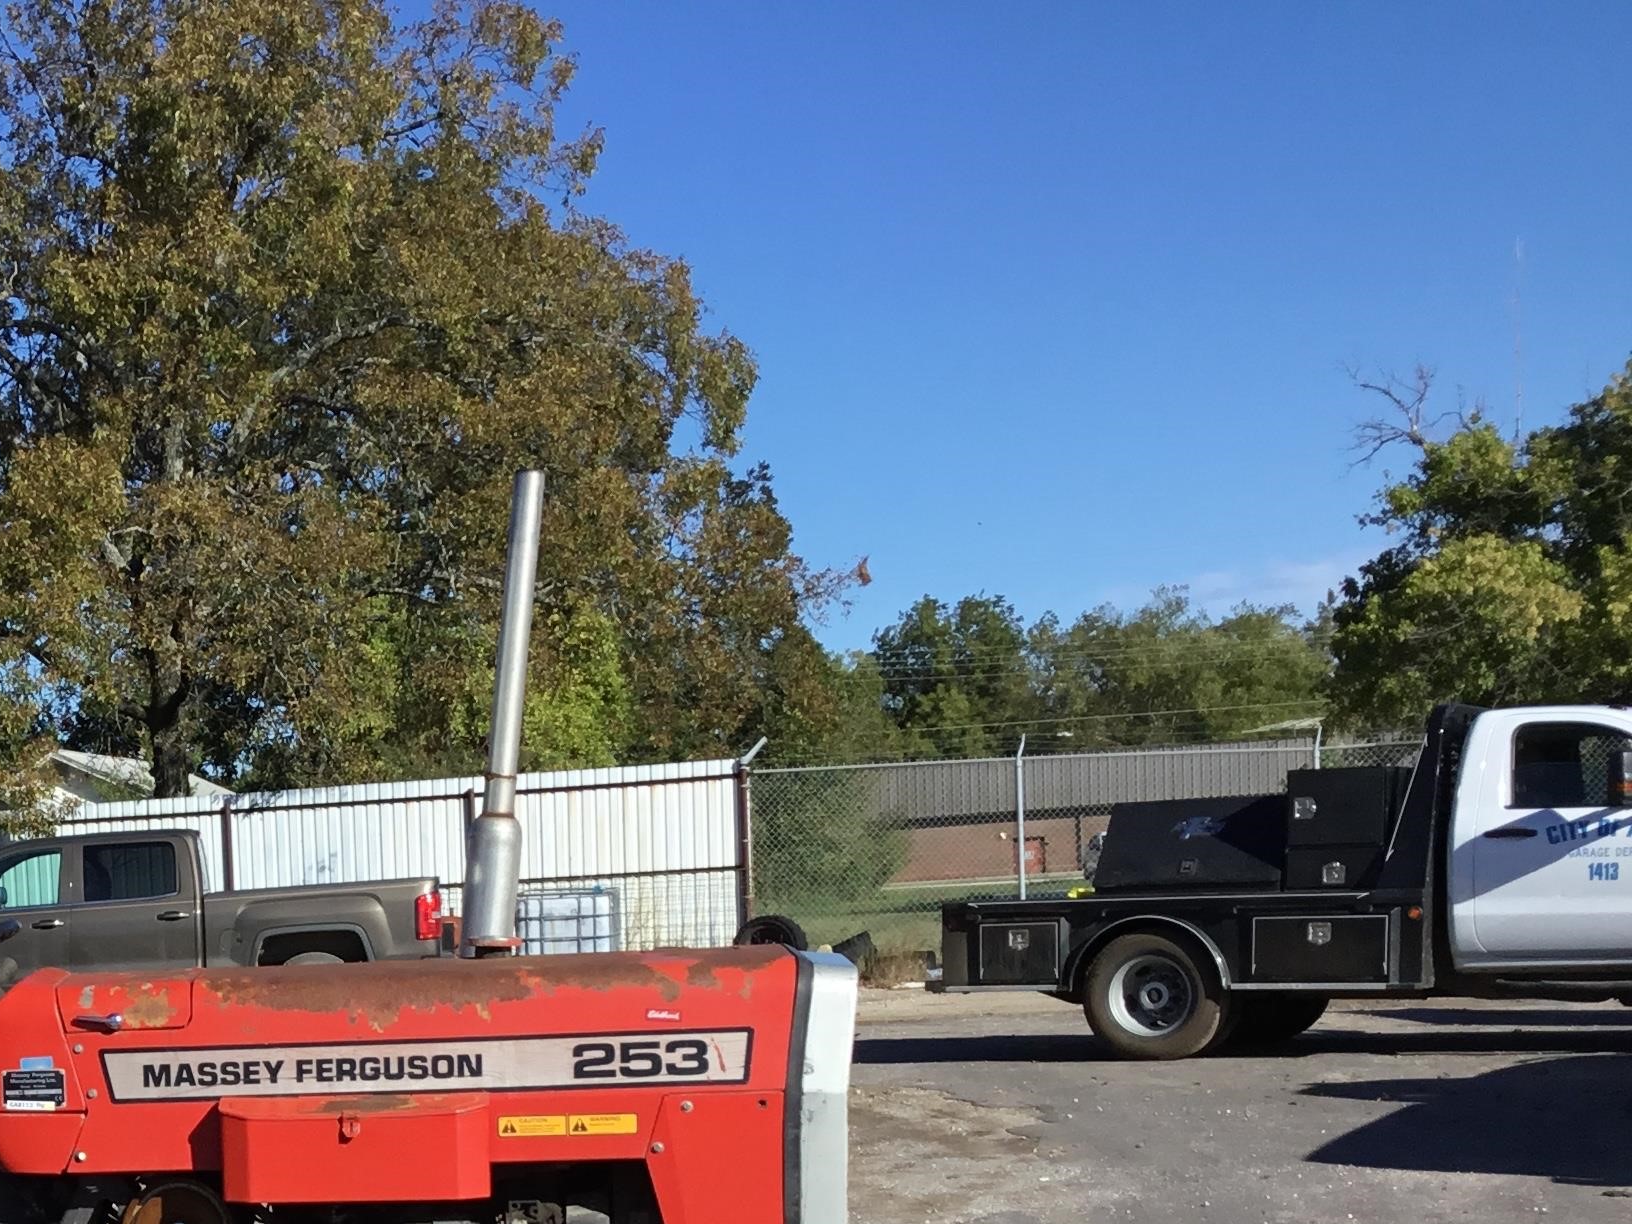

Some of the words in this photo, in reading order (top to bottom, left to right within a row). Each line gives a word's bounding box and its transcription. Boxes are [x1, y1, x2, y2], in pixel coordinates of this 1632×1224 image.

[1546, 821, 1590, 844] CITY
[1598, 818, 1621, 836] OF
[1588, 862, 1619, 881] 1413
[142, 1061, 284, 1088] MASSEY
[295, 1054, 483, 1083] FERGUSON
[572, 1039, 709, 1079] 253
